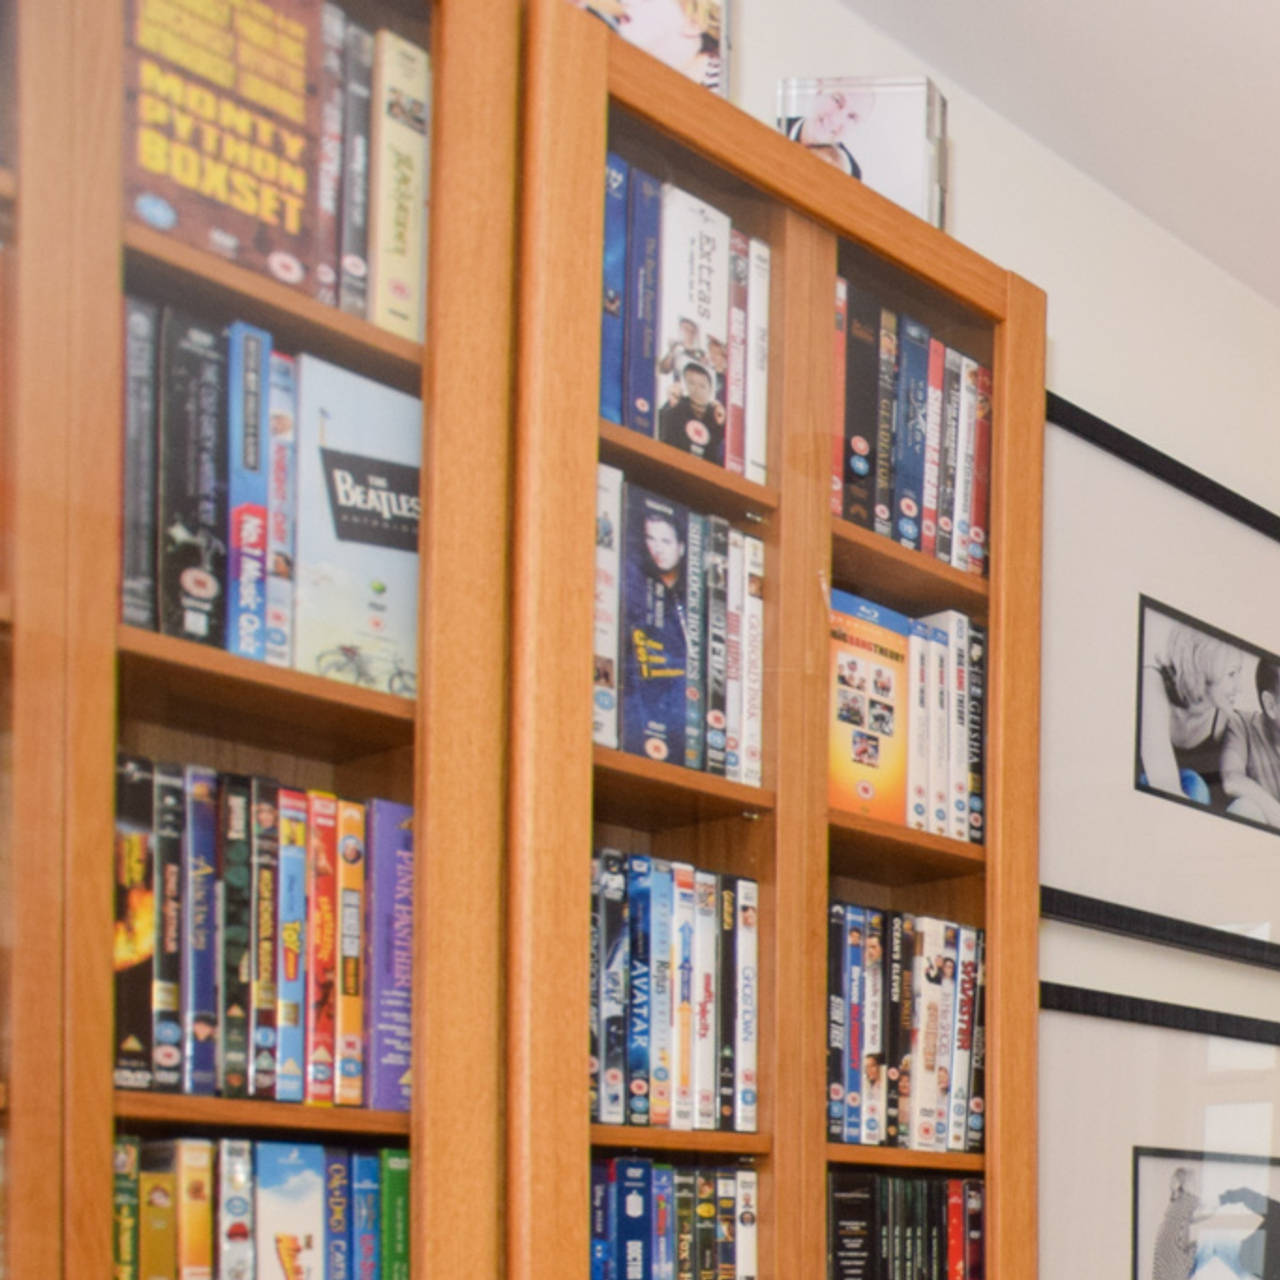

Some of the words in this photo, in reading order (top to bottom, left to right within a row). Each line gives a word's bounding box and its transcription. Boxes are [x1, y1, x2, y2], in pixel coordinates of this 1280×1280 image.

[138, 58, 307, 158] MONTY
[138, 92, 308, 196] PYTHON
[138, 126, 302, 237] BOXSET
[697, 231, 717, 320] Extras
[332, 467, 421, 520] BEATLES
[687, 522, 702, 610] SHERLOCK
[687, 612, 702, 681] HOLMES
[968, 700, 982, 764] GEISHA
[393, 849, 414, 898] PINK
[392, 902, 414, 988] PANTHER
[631, 959, 649, 1049] AVATAR
[957, 960, 976, 1050] SYLVESTER
